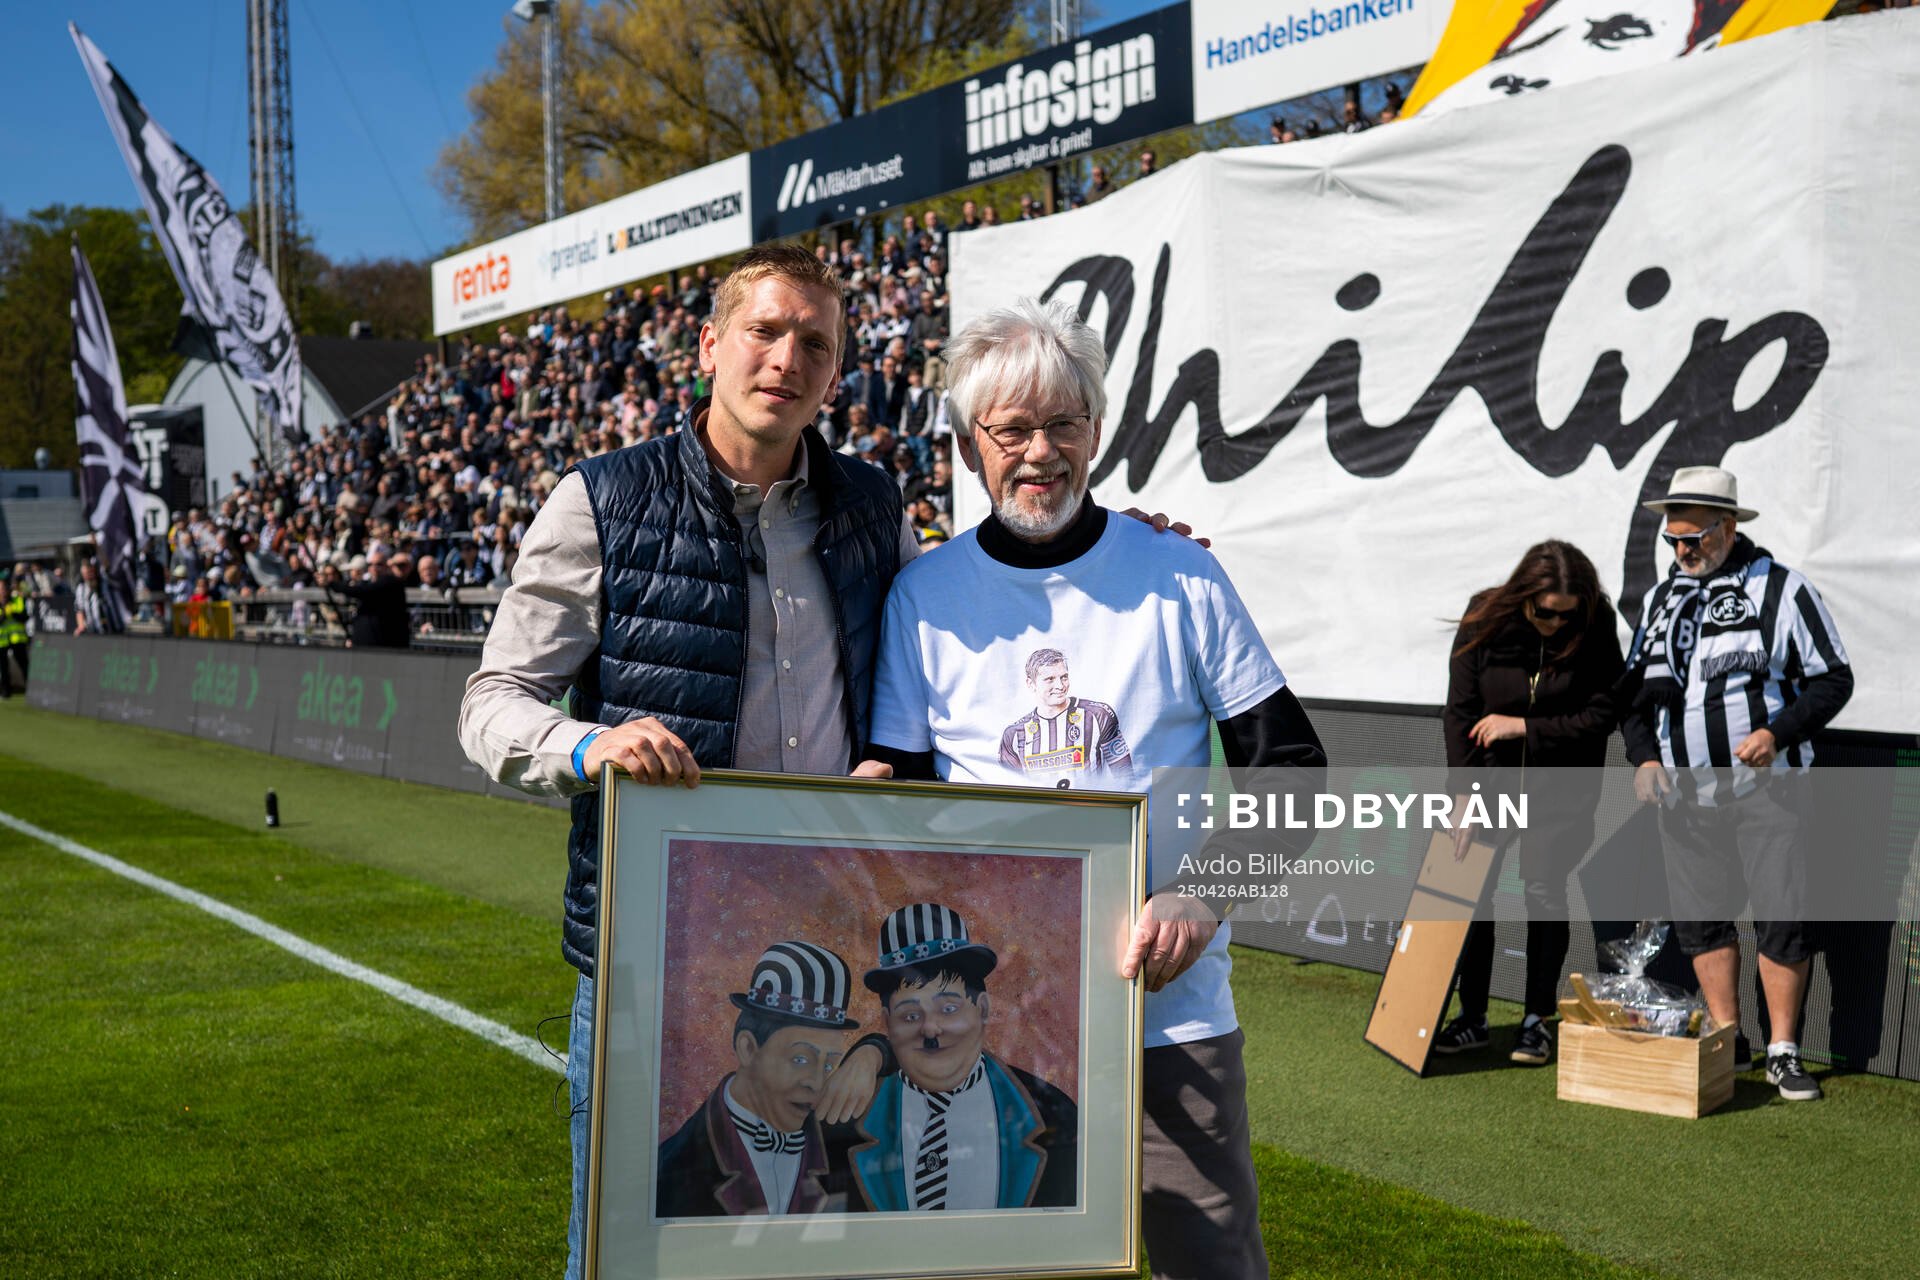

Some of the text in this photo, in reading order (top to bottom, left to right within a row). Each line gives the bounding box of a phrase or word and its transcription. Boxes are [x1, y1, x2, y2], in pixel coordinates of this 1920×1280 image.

[1205, 0, 1414, 70] Handelsbanken
[815, 152, 905, 201] Mäklarhuset
[1012, 143, 1050, 169] skyltar
[1049, 135, 1061, 158] &
[1060, 126, 1093, 158] print!
[606, 189, 744, 255] LOKALTIDNINGEN
[452, 250, 512, 305] renta
[191, 646, 240, 708] akea
[297, 655, 365, 728] akea
